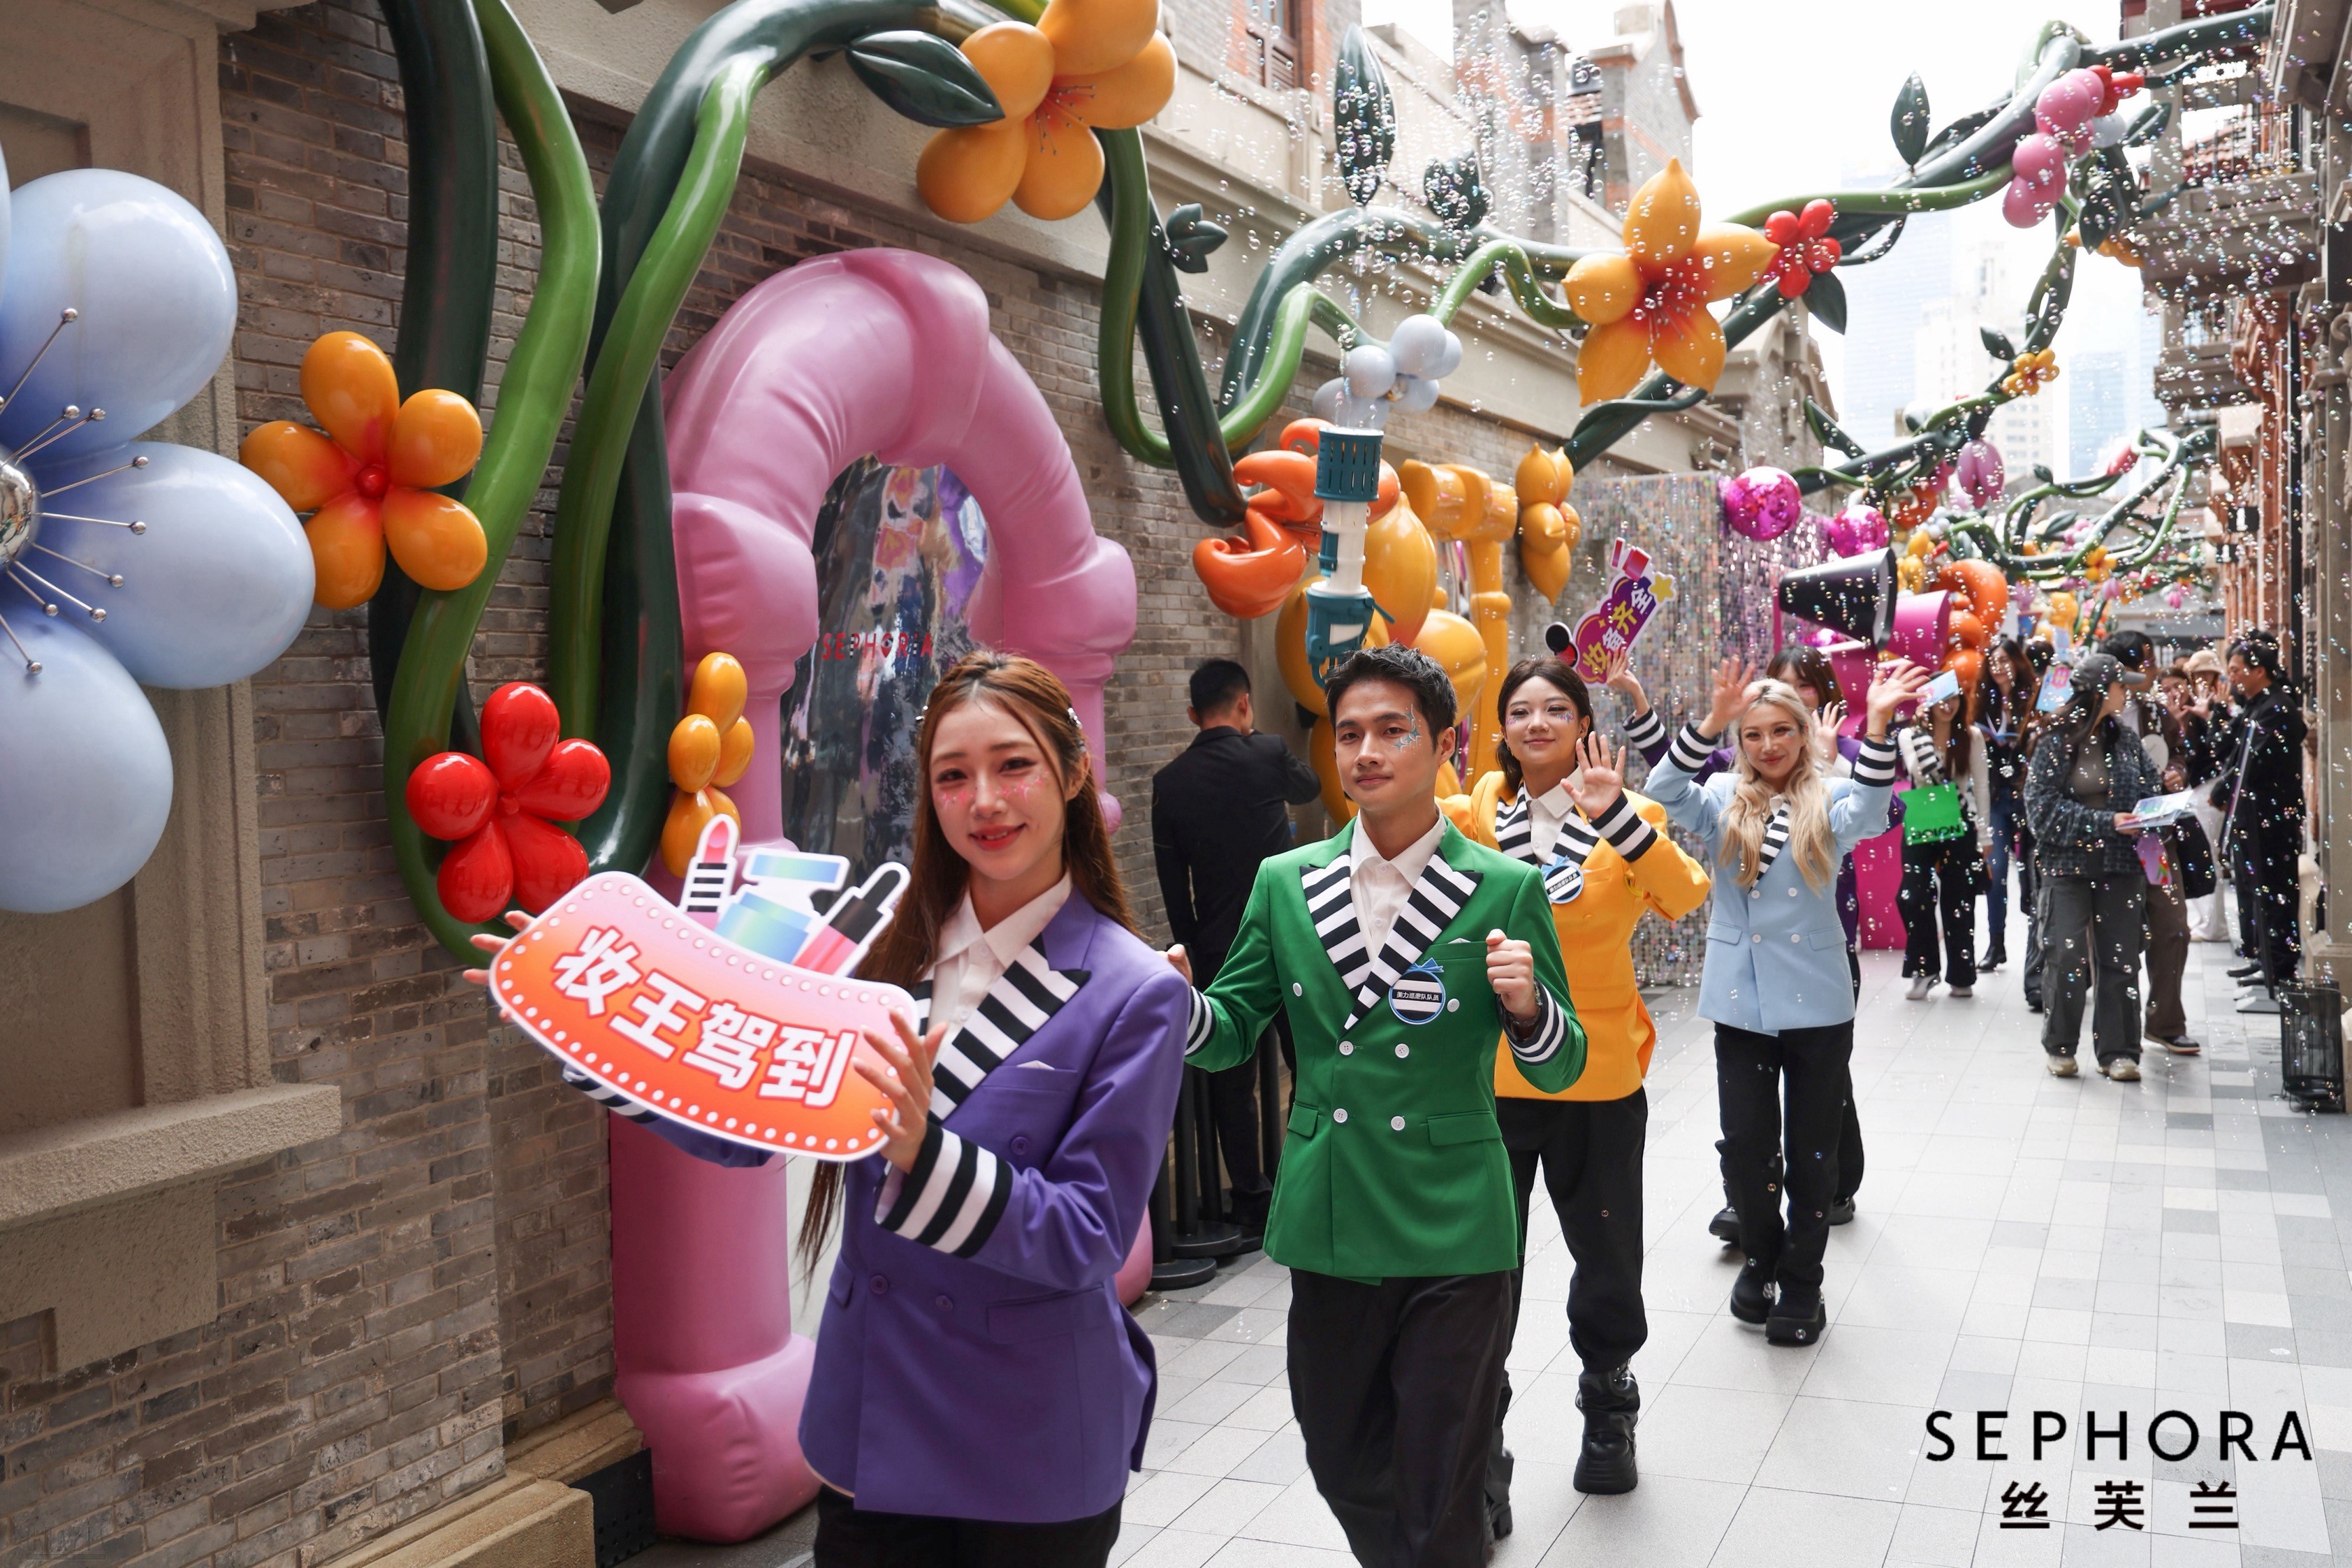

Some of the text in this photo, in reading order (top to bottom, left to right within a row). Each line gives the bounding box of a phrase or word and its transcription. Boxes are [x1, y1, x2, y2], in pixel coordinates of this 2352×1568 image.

[1582, 588, 1653, 675] 妆备齐全
[553, 927, 856, 1108] 妆王驾到
